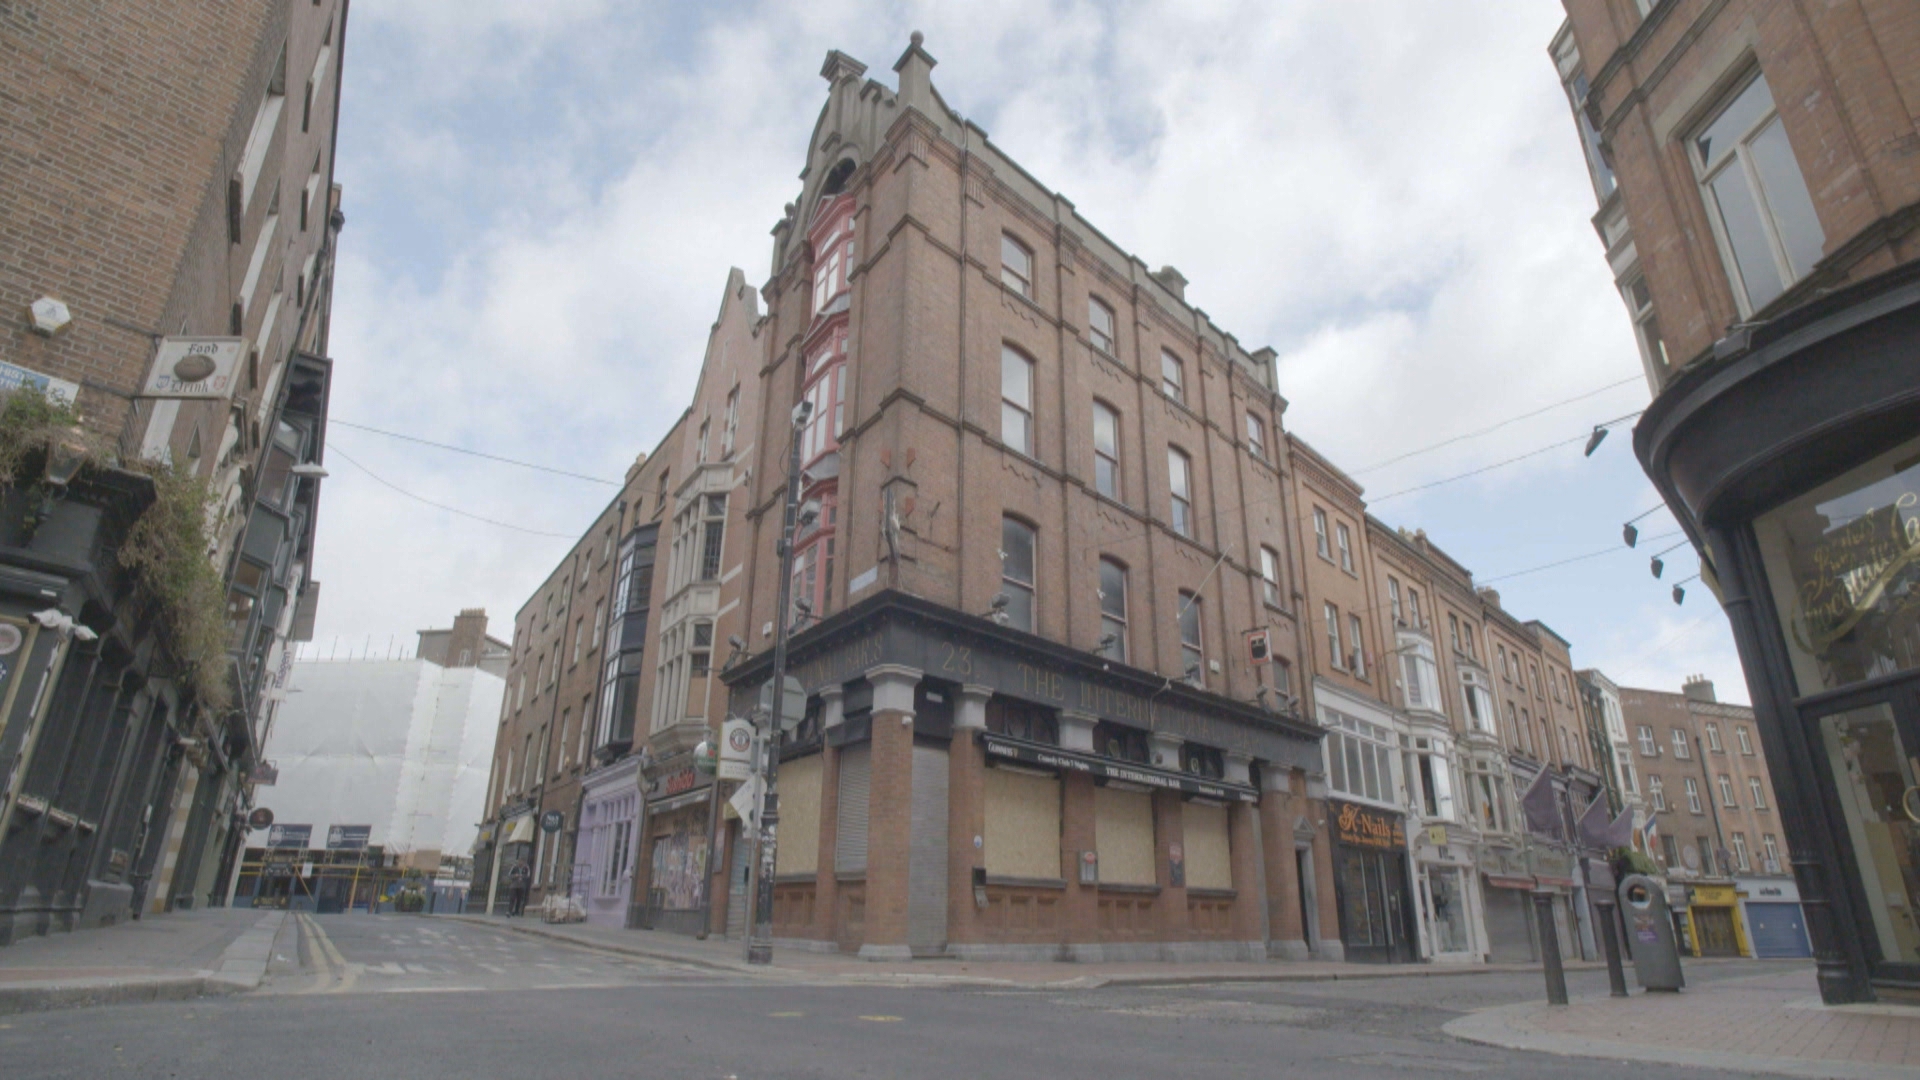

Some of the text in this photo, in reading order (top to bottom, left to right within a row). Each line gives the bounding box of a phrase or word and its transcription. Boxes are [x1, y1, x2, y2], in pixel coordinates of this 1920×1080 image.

[188, 343, 219, 355] Food
[172, 379, 209, 393] Drink
[1017, 662, 1065, 702] THE
[1080, 680, 1220, 742] INTERNATIONAL
[1105, 765, 1181, 789] THE INTERNATIONAL BAR
